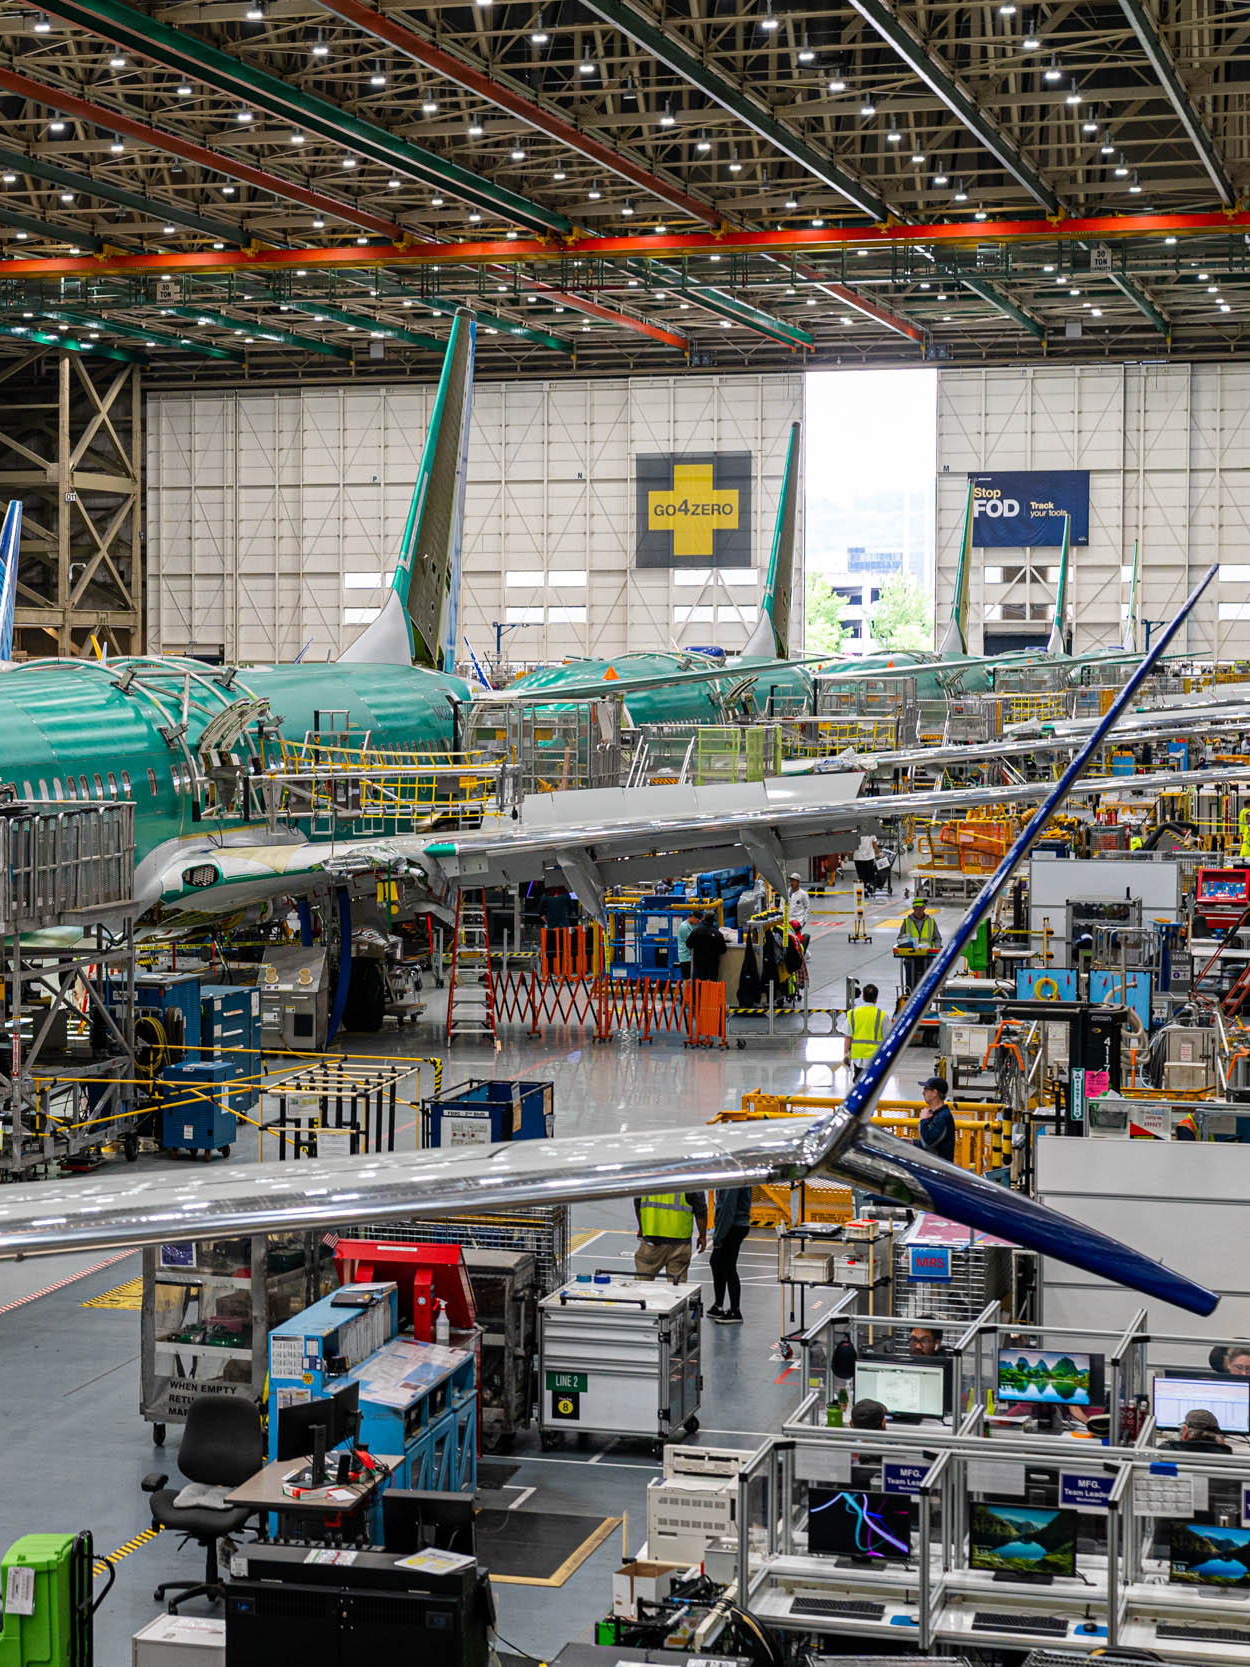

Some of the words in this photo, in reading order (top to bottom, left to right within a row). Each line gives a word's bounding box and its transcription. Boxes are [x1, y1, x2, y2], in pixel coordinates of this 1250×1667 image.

[1095, 258, 1108, 266] TON
[974, 487, 1001, 499] Stop
[653, 498, 734, 517] GO4ZERO
[973, 499, 1020, 518] FOD
[1030, 501, 1054, 510] Track
[1030, 510, 1046, 519] your
[915, 1256, 945, 1269] MRS
[555, 1374, 572, 1387] LINE
[573, 1375, 579, 1388] 2
[170, 1380, 198, 1393] WHEN
[200, 1384, 237, 1395] EMPTY
[168, 1394, 194, 1404] RETU
[563, 1402, 569, 1412] 8
[900, 1468, 922, 1479] MFG.
[886, 1477, 906, 1485] Team
[906, 1479, 921, 1487] Lea
[1077, 1479, 1102, 1490] MFG.
[1064, 1488, 1084, 1497] Team
